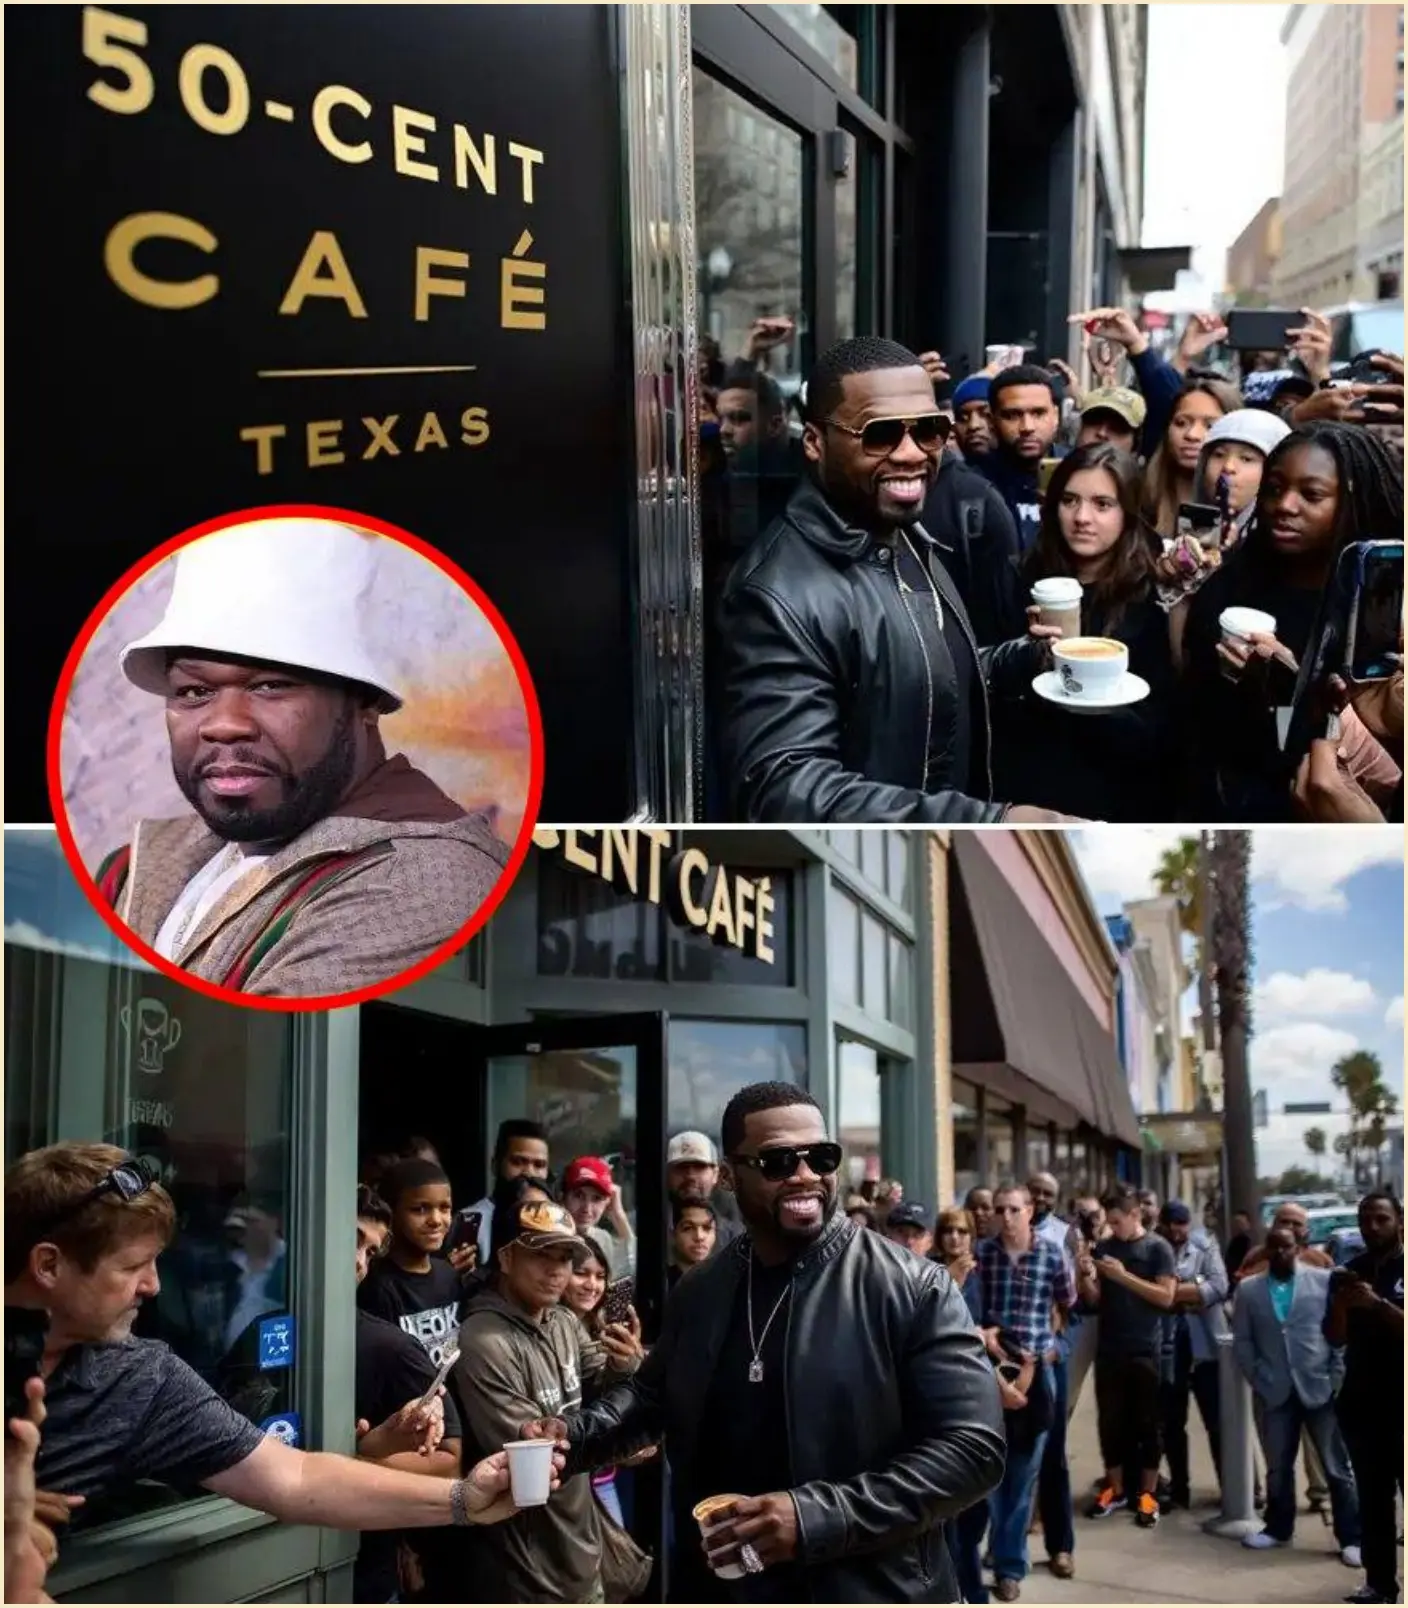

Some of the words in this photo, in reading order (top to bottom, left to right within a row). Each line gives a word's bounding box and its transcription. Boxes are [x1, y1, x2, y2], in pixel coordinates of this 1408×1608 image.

[82, 6, 545, 204] 50-CENT
[104, 211, 547, 330] CAFÉ
[240, 406, 491, 475] TEXAS
[679, 848, 775, 965] CAFÉ
